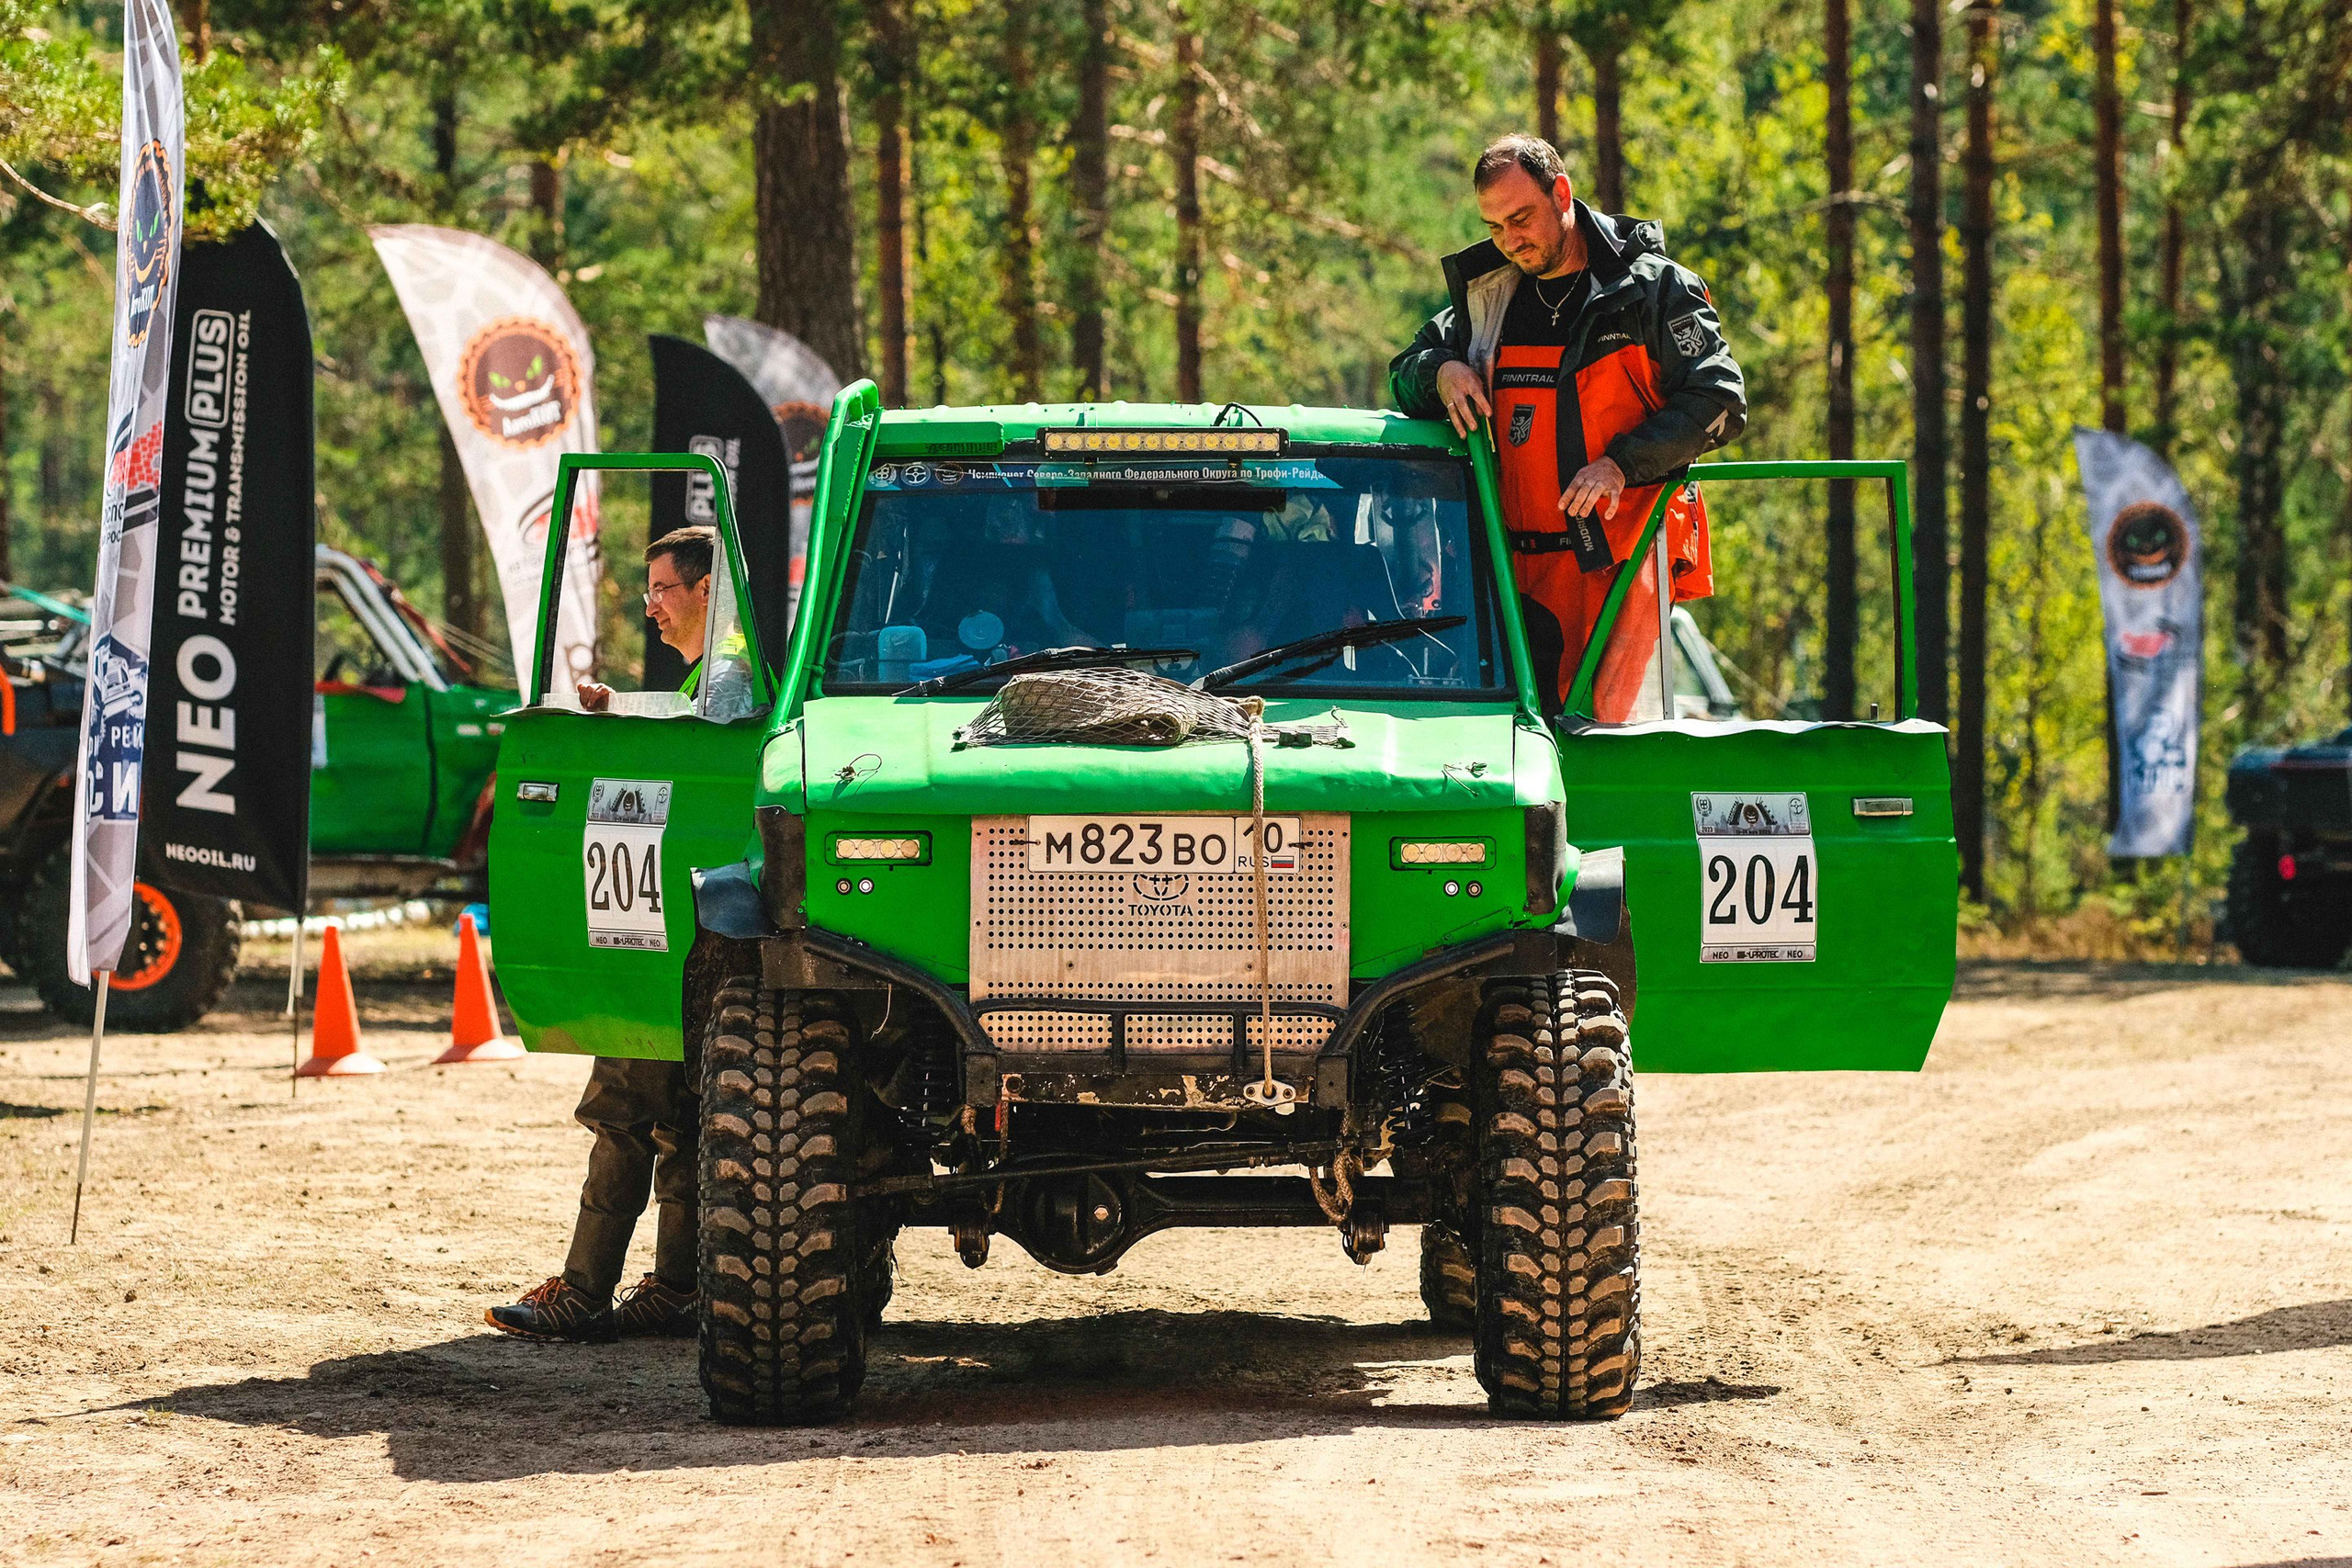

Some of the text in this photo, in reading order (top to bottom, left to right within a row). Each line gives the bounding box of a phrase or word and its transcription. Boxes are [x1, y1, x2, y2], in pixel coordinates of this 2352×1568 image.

[1501, 374, 1555, 383] FINNTRAIL
[177, 318, 228, 619] PREMIUM PLUS
[219, 309, 251, 626] MOTOR & TRANSMISSION OIL
[1125, 468, 1199, 479] Федерального
[1203, 467, 1238, 479] Округа
[1240, 468, 1252, 478] по
[1255, 467, 1327, 480] Трофи-Рейда
[176, 634, 237, 815] NEO
[165, 842, 256, 873] NEOOIL.RU
[587, 841, 662, 912] 204
[1708, 854, 1814, 925] 204
[1128, 904, 1194, 917] TOYOTA
[595, 936, 608, 944] NEO
[650, 939, 661, 947] NEO
[1713, 951, 1729, 959] NEO
[1787, 950, 1804, 958] NEO
